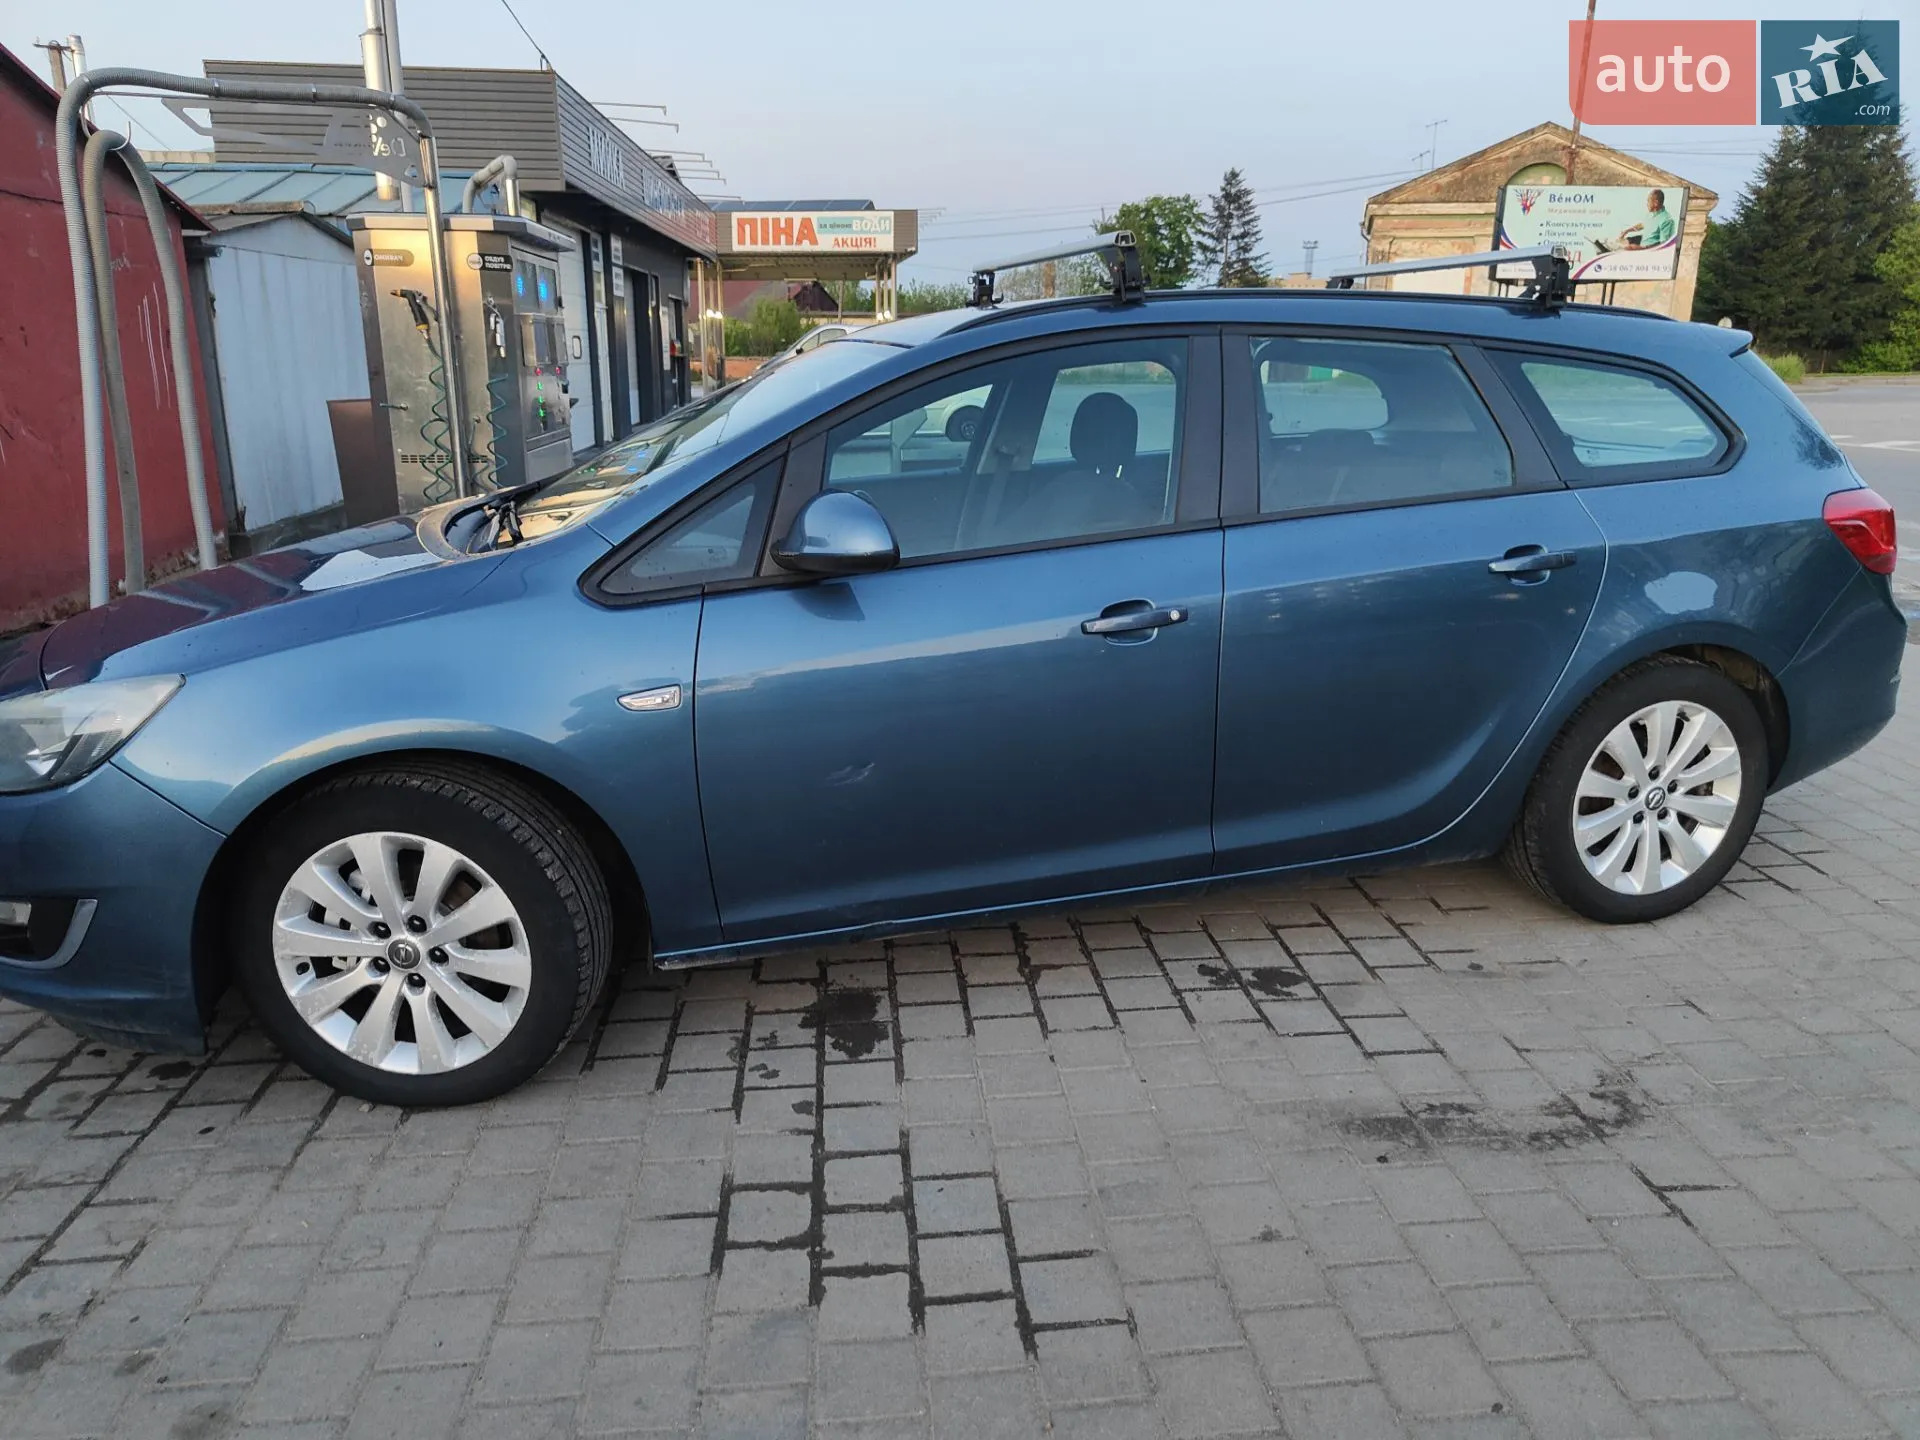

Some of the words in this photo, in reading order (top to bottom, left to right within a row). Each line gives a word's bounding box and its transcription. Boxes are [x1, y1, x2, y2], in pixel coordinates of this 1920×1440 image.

[736, 217, 819, 246] ПІНА
[852, 218, 890, 233] ВОДИ
[832, 236, 878, 249] АКЦІЯ!
